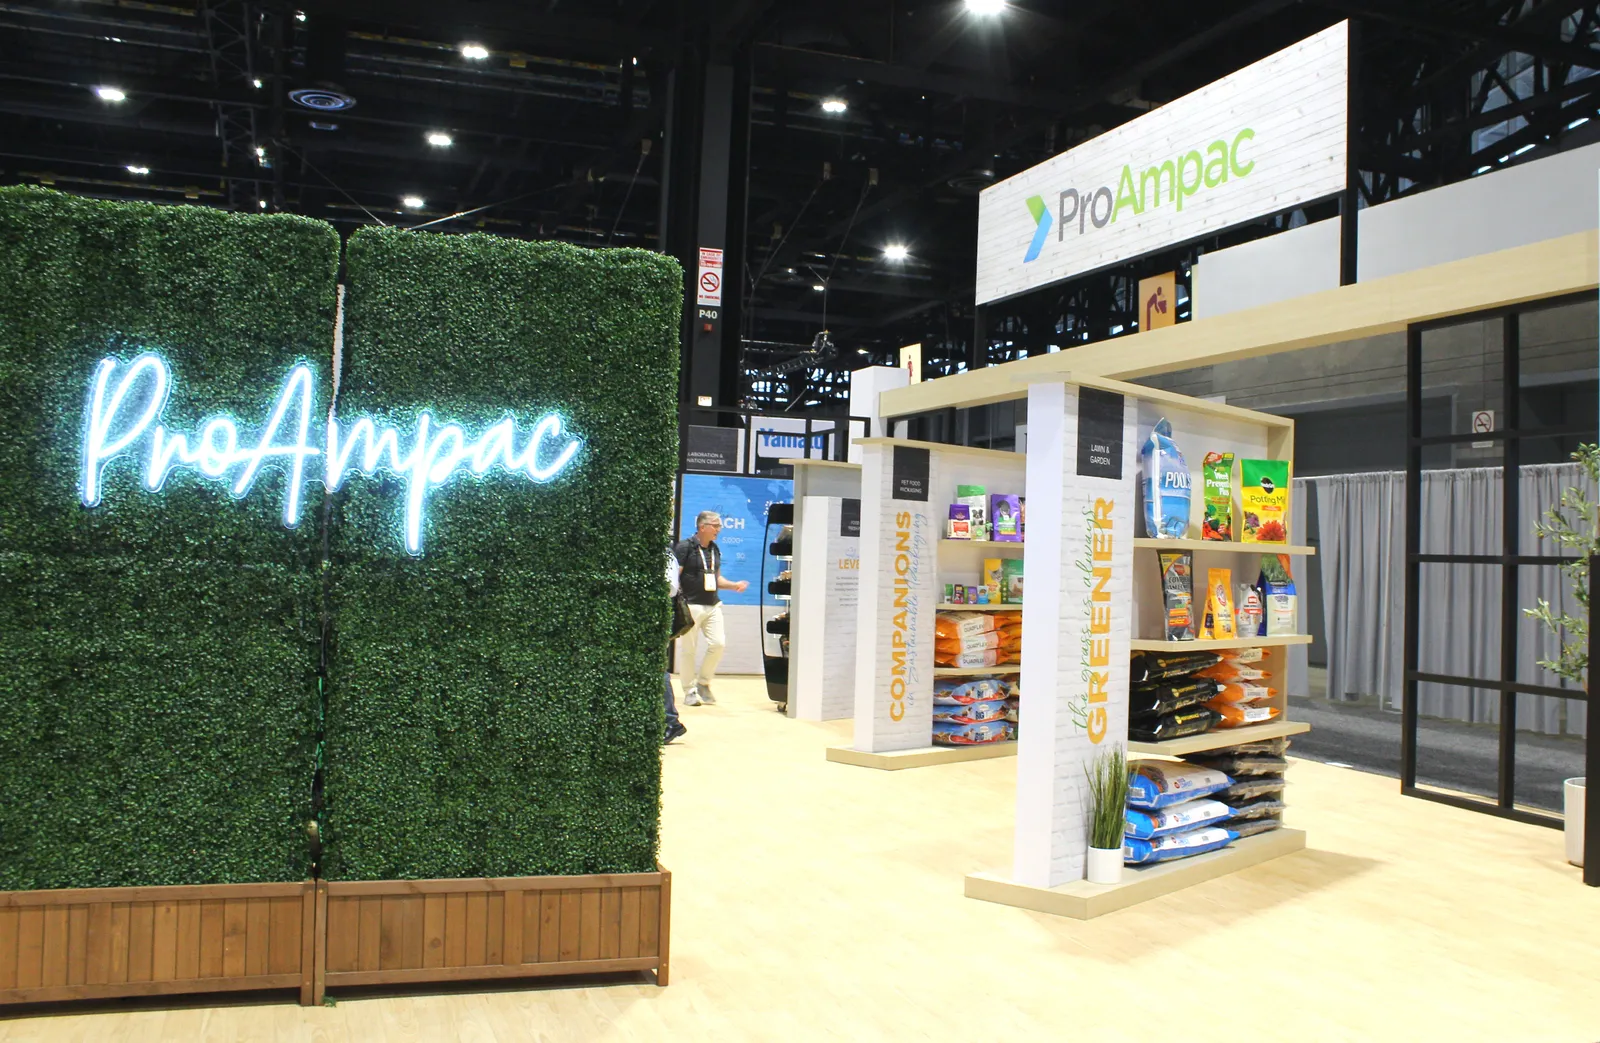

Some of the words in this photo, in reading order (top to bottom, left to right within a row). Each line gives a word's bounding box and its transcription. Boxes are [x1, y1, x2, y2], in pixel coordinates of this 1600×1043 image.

[1058, 127, 1256, 242] ProAmpac
[699, 310, 718, 319] P40
[82, 354, 584, 554] ProAmpac
[1090, 455, 1110, 465] GARDEN
[1091, 444, 1105, 453] LAWN
[1250, 495, 1276, 505] Potting
[1075, 503, 1104, 588] always
[890, 511, 911, 722] COMPANIONS
[1083, 598, 1093, 617] is
[1086, 497, 1114, 745] GREENER
[1080, 627, 1100, 685] grass
[1067, 693, 1088, 735] the
